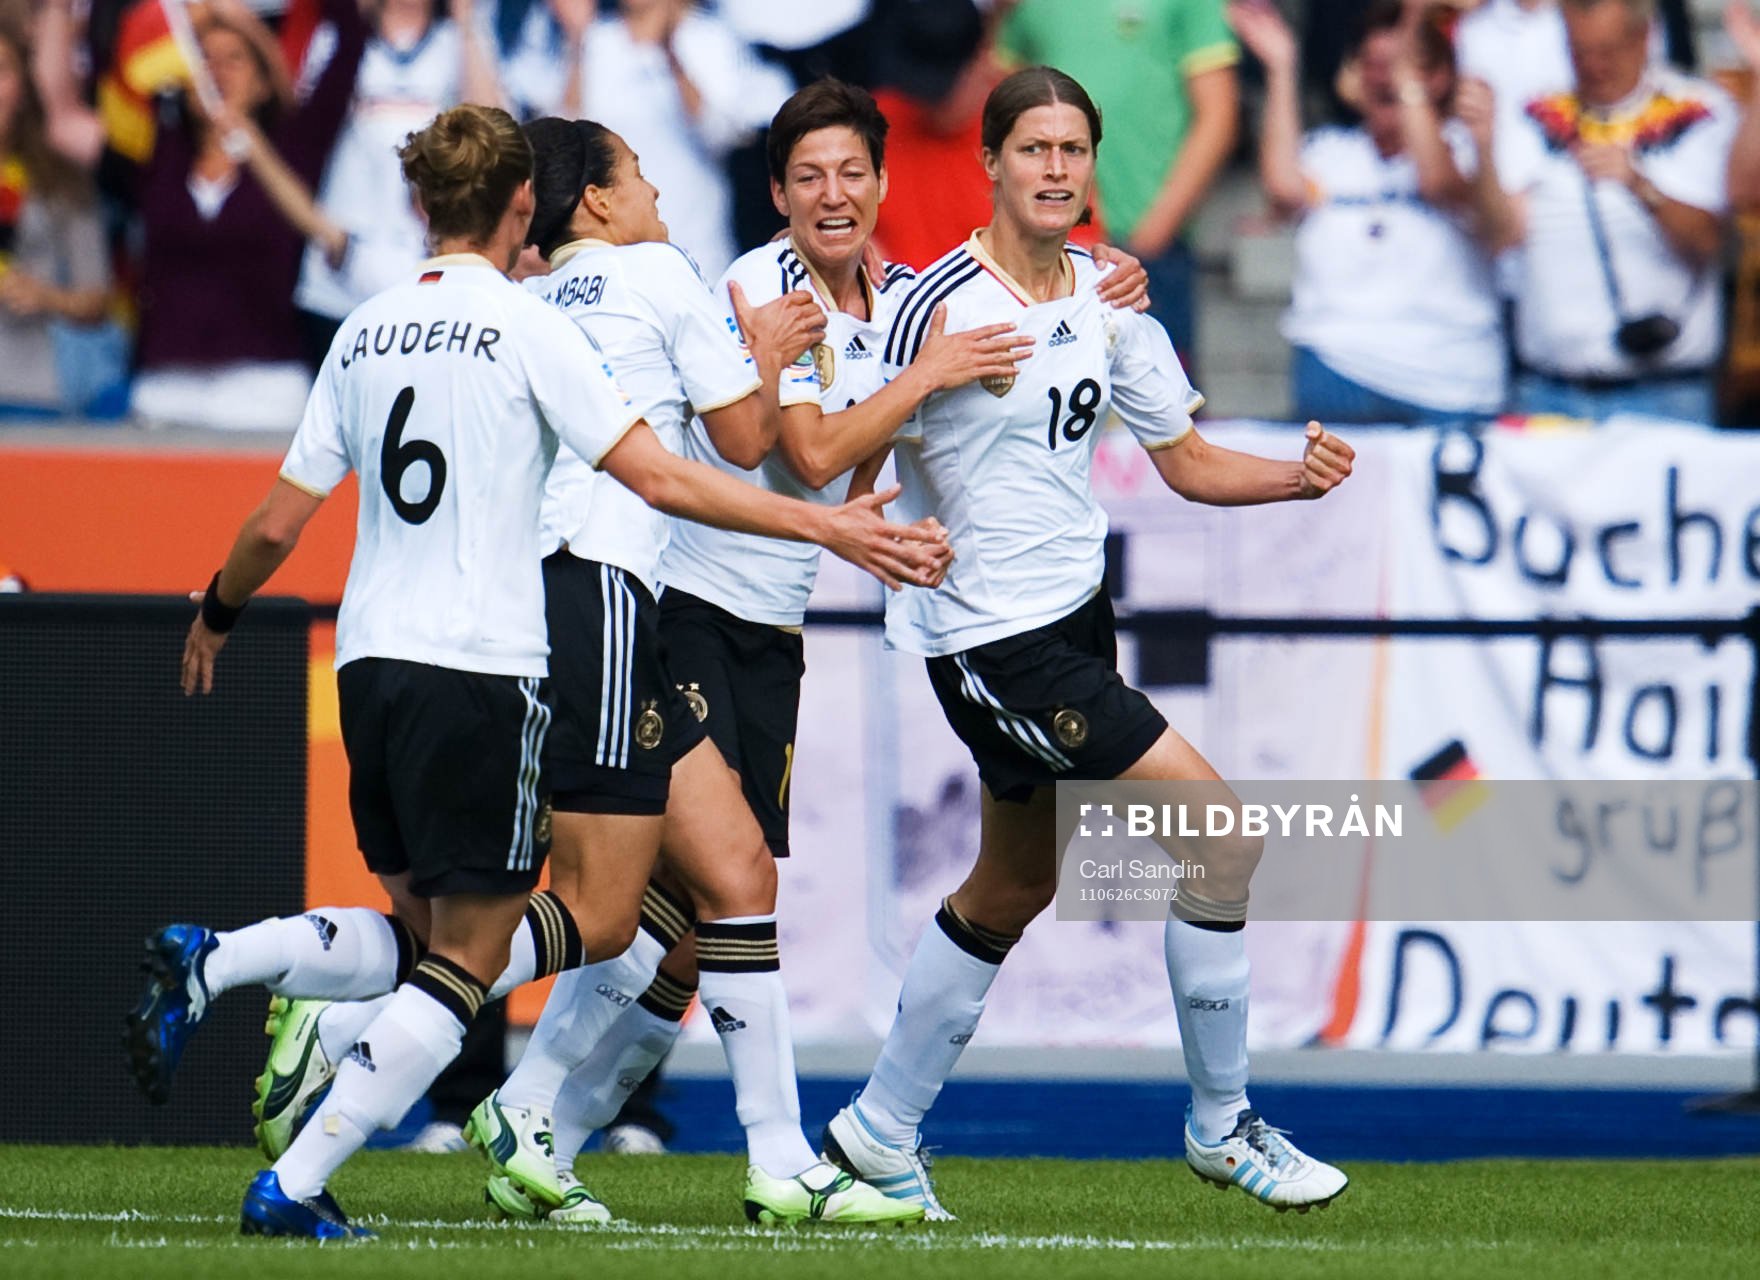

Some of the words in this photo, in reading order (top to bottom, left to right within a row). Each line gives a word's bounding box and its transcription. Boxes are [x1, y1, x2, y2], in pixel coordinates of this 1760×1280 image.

[380, 386, 447, 525] 6
[1047, 378, 1102, 451] 18
[1530, 617, 1750, 760] Hai
